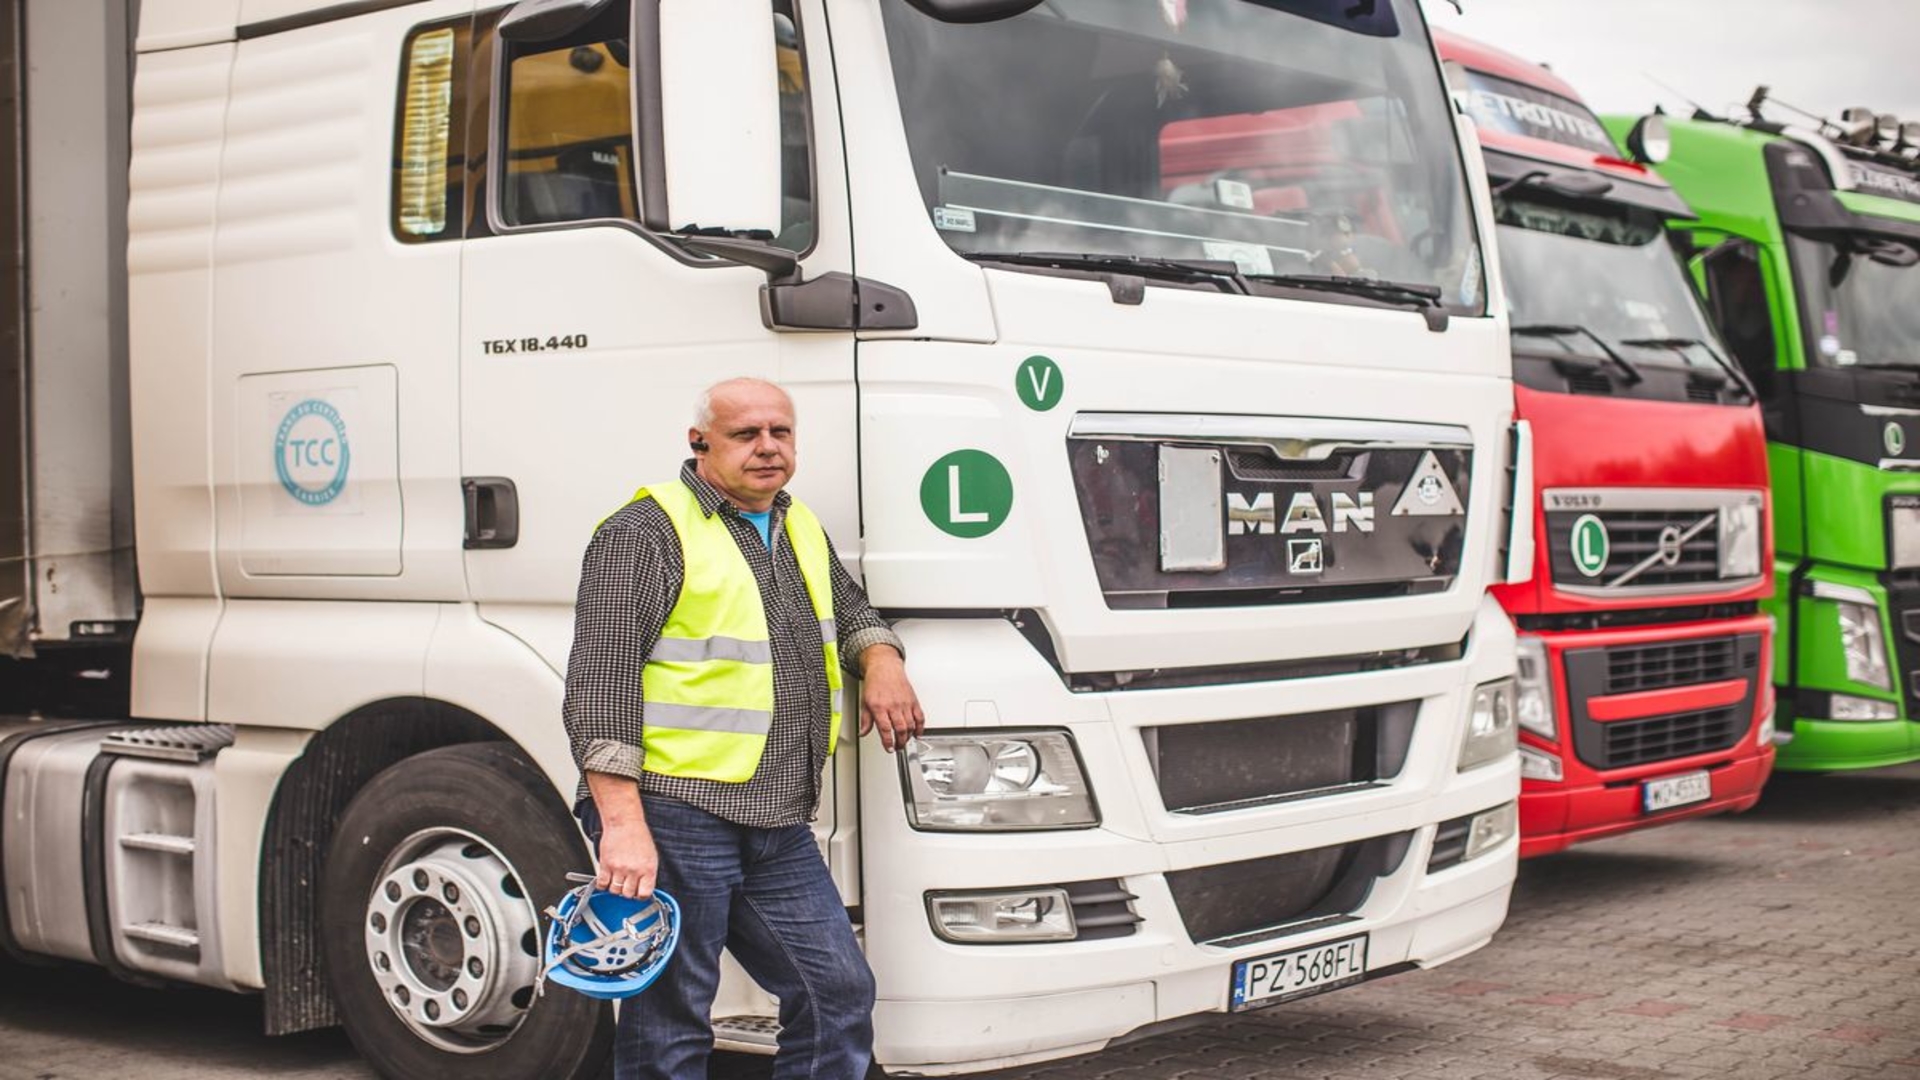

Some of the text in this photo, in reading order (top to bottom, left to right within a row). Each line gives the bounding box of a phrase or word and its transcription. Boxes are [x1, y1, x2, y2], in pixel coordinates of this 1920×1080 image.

[520, 334, 588, 352] 18.440
[1027, 365, 1052, 402] V
[289, 438, 335, 467] TCC
[948, 464, 990, 523] L
[1552, 495, 1602, 507] VOLVO
[1226, 492, 1375, 535] MAN
[1582, 526, 1601, 565] L
[1249, 942, 1359, 997] PZ 568FL
